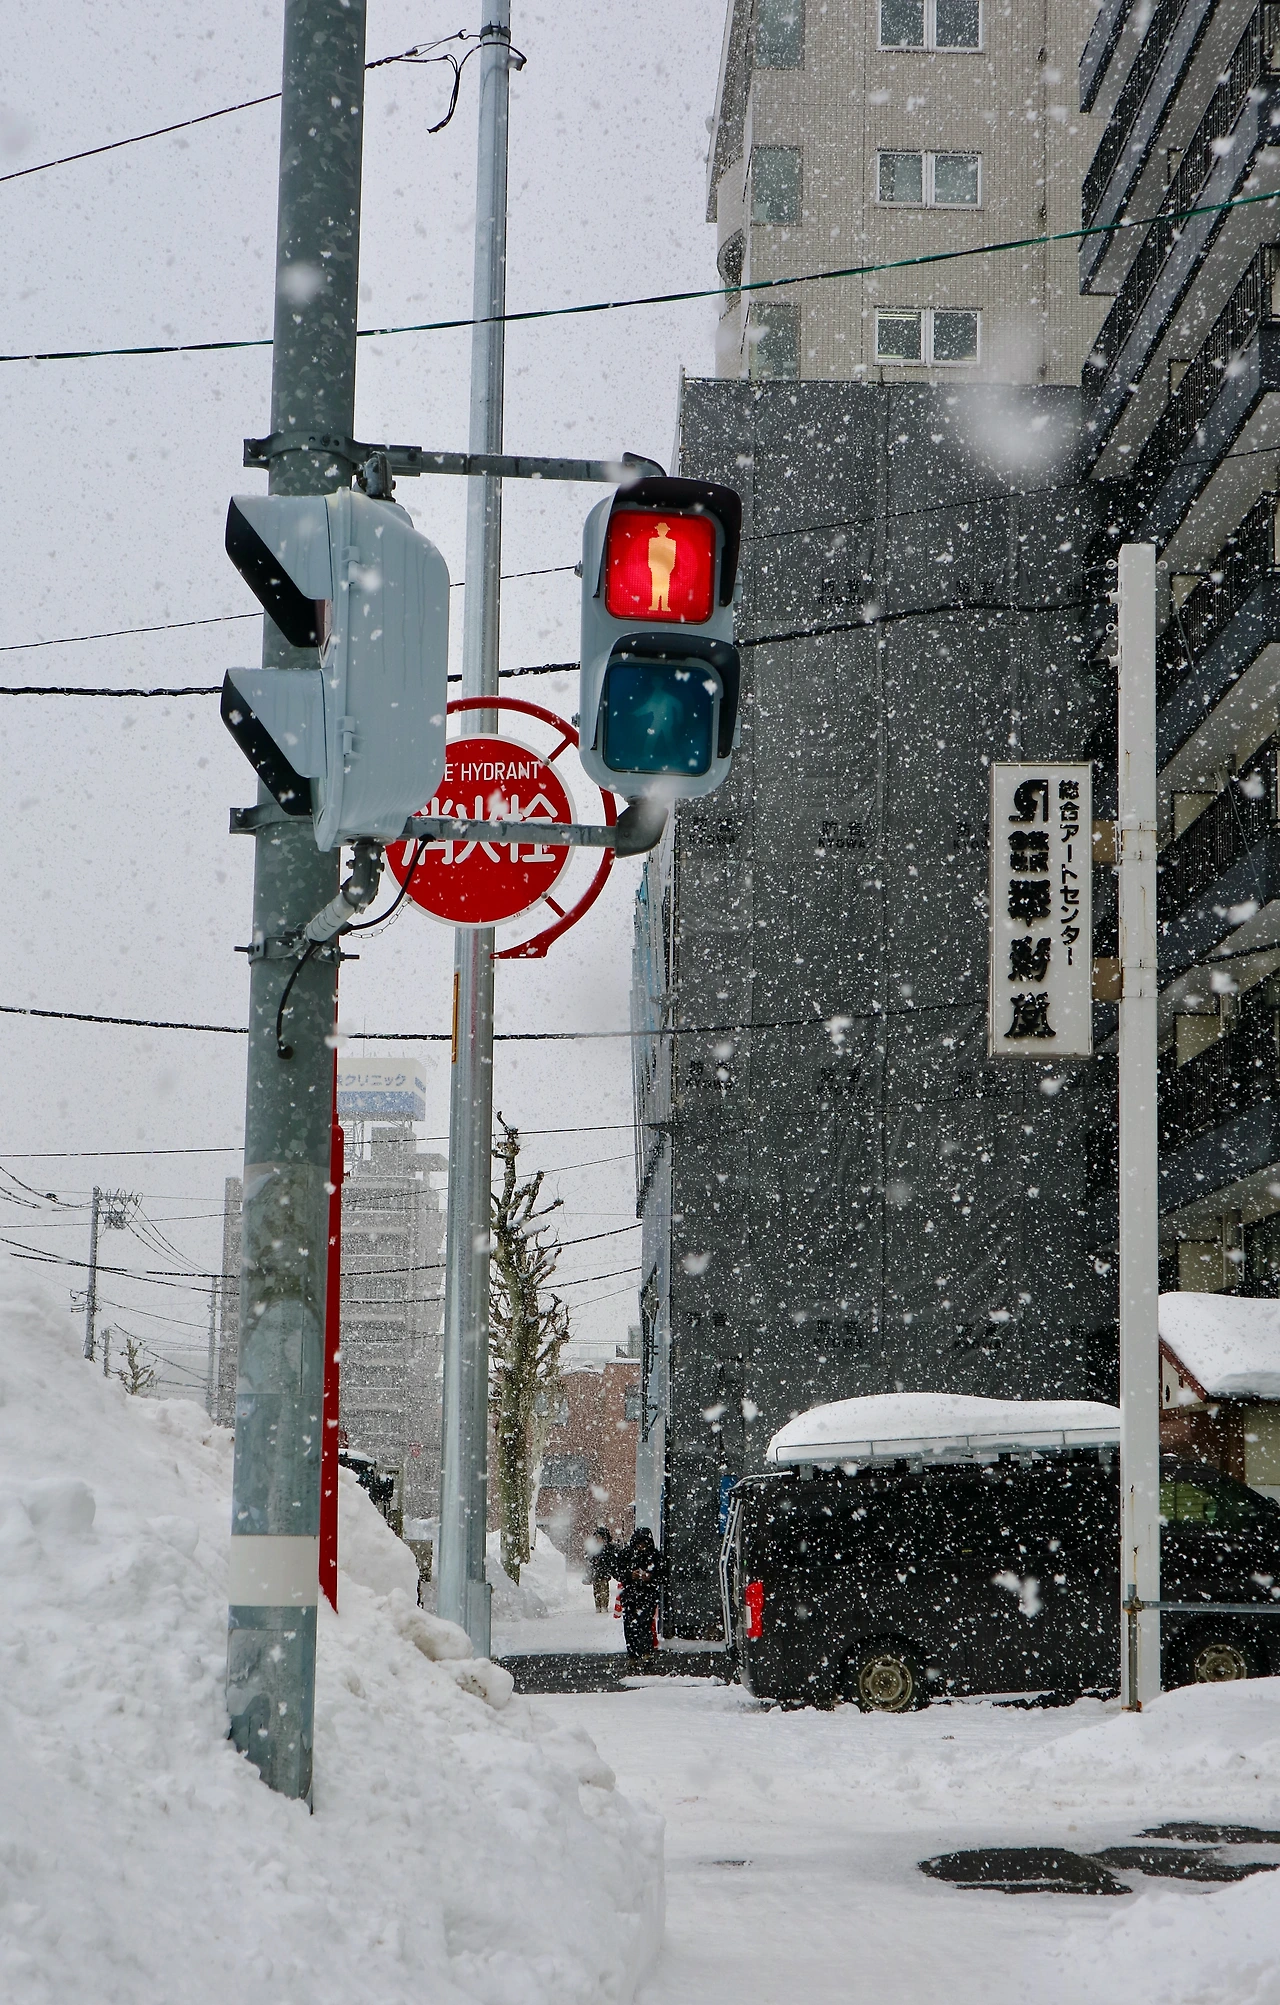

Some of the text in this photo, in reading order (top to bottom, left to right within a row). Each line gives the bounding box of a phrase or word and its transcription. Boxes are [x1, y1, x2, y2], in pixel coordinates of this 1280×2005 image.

[461, 760, 540, 782] HYDRANT
[401, 793, 558, 867] 消火栓
[817, 837, 866, 849] KYOWA
[1058, 779, 1081, 966] 総合アートセンター
